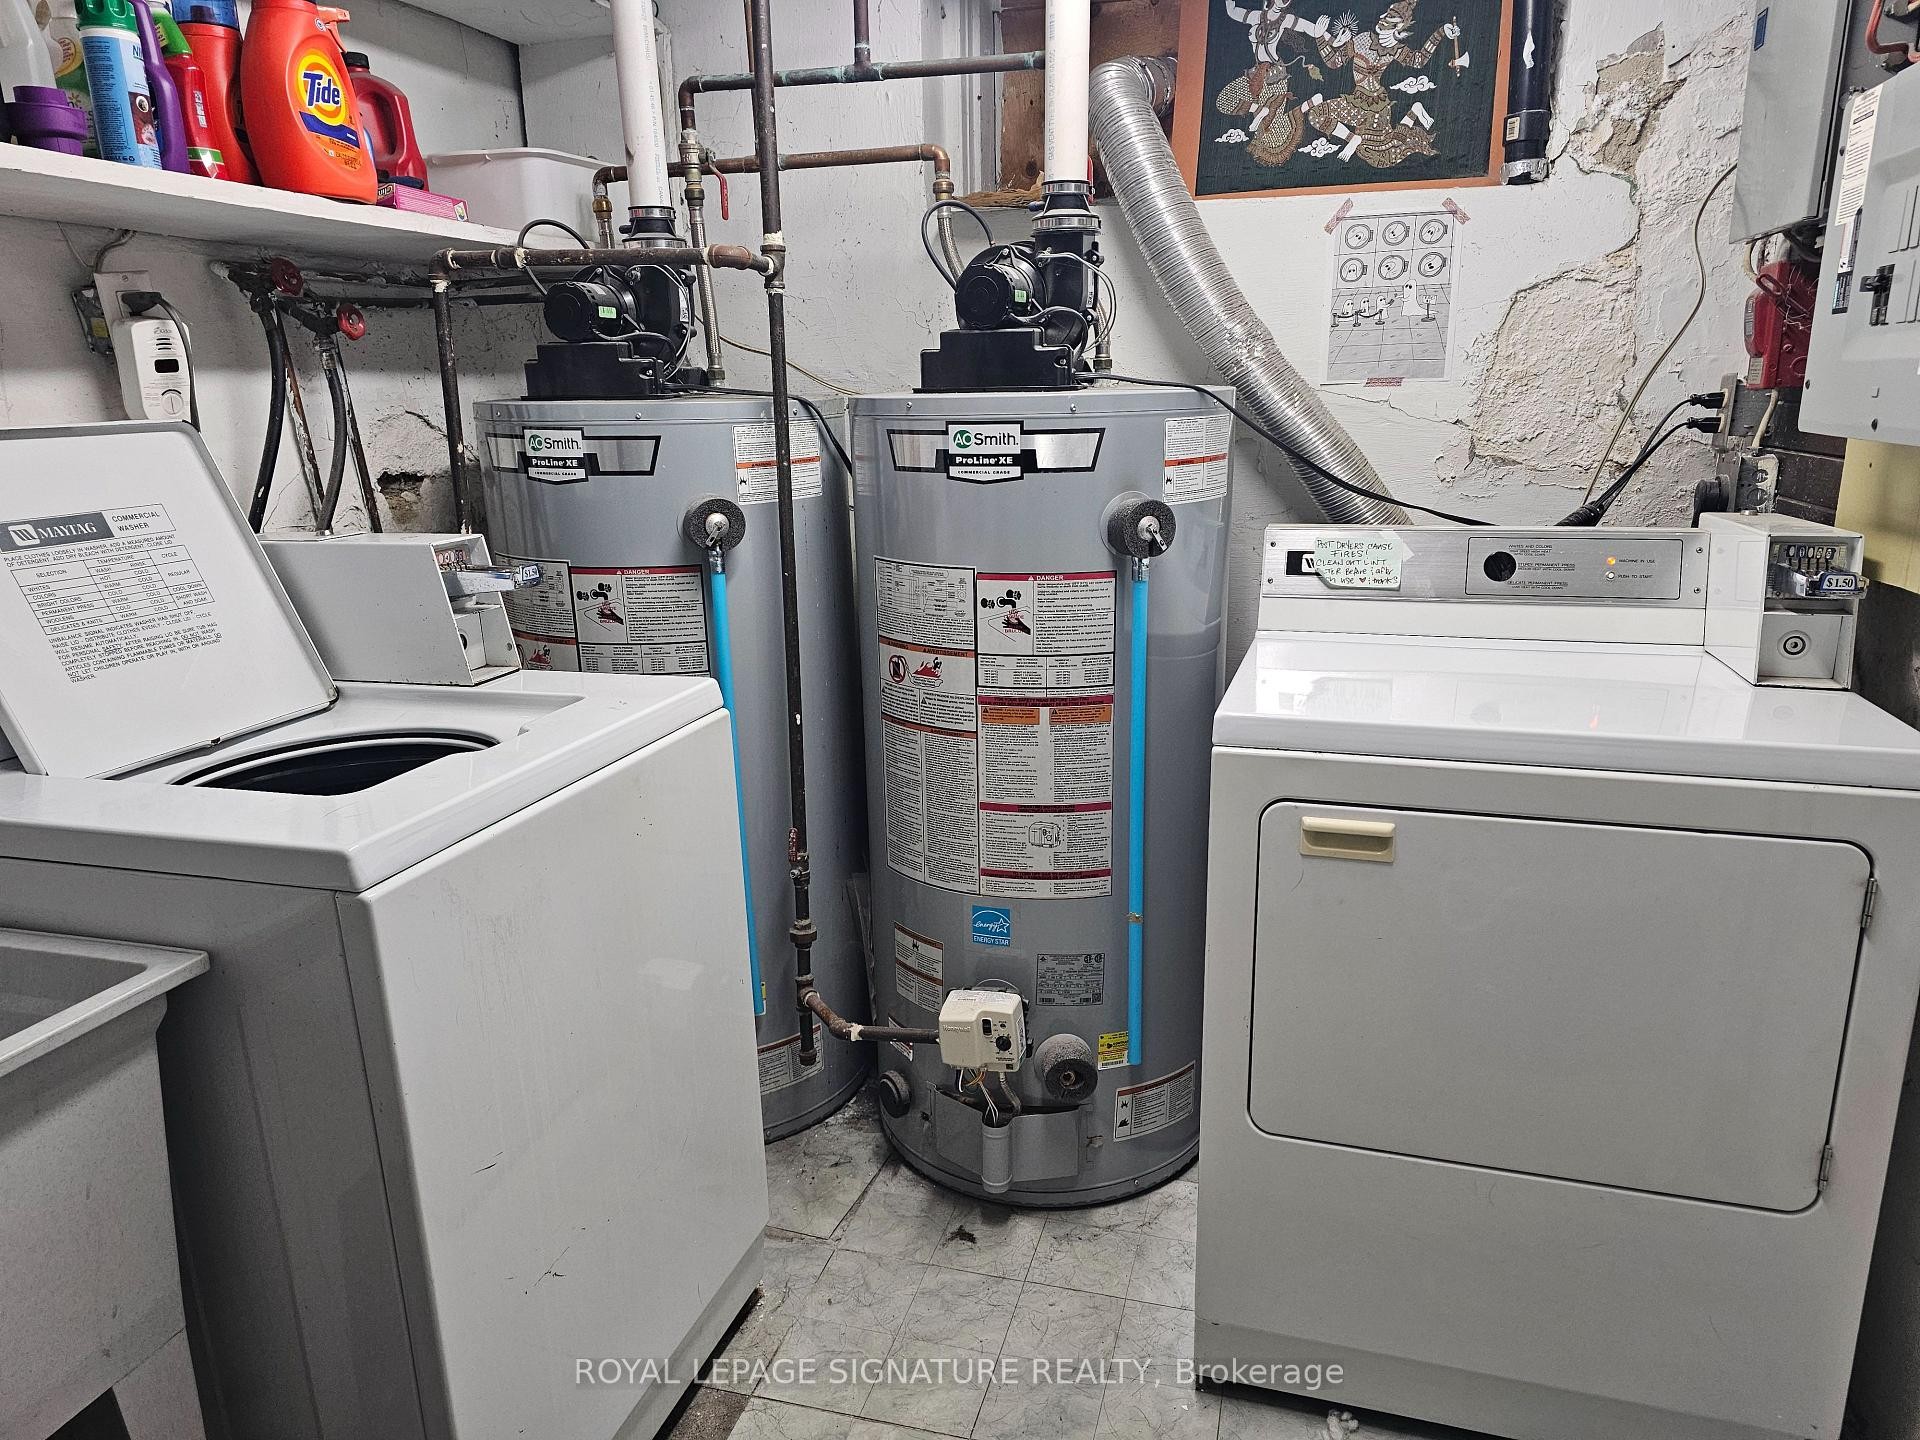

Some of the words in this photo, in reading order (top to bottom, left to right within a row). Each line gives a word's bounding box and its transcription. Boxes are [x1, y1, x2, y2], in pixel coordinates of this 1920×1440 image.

[303, 71, 341, 107] Tide
[566, 459, 578, 467] XE
[999, 456, 1014, 465] XE
[111, 511, 161, 522] COMMERCIAL
[38, 522, 97, 539] MAYTAG
[118, 522, 149, 532] WASHER
[24, 552, 51, 560] CLOTHES
[52, 548, 76, 556] LOOSELY
[127, 537, 154, 545] MEASURED
[1336, 540, 1364, 550] DRYERS
[97, 555, 134, 564] TEMPERATURE
[1316, 559, 1344, 567] CLEAN
[36, 570, 67, 578] SELECTION
[168, 569, 190, 577] REGULAR
[28, 584, 51, 592] WHITES
[1826, 577, 1854, 589] $1.50
[33, 592, 57, 600] COLORS
[60, 596, 82, 604] COLORS
[41, 606, 75, 616] PERMANENT
[46, 614, 75, 624] WOOLENS
[49, 633, 83, 643] UNBALANCE
[84, 629, 104, 637] SIGNAL
[105, 622, 133, 632] INDICATES
[134, 618, 156, 626] WASHER
[50, 622, 81, 632] DELICATES
[70, 643, 93, 651] RESUME
[72, 648, 101, 657] PERSONAL
[61, 655, 97, 666] COMPLETELY
[65, 662, 91, 672] ARTICLES
[92, 655, 126, 666] CONTAINING
[973, 935, 995, 944] ENERGY
